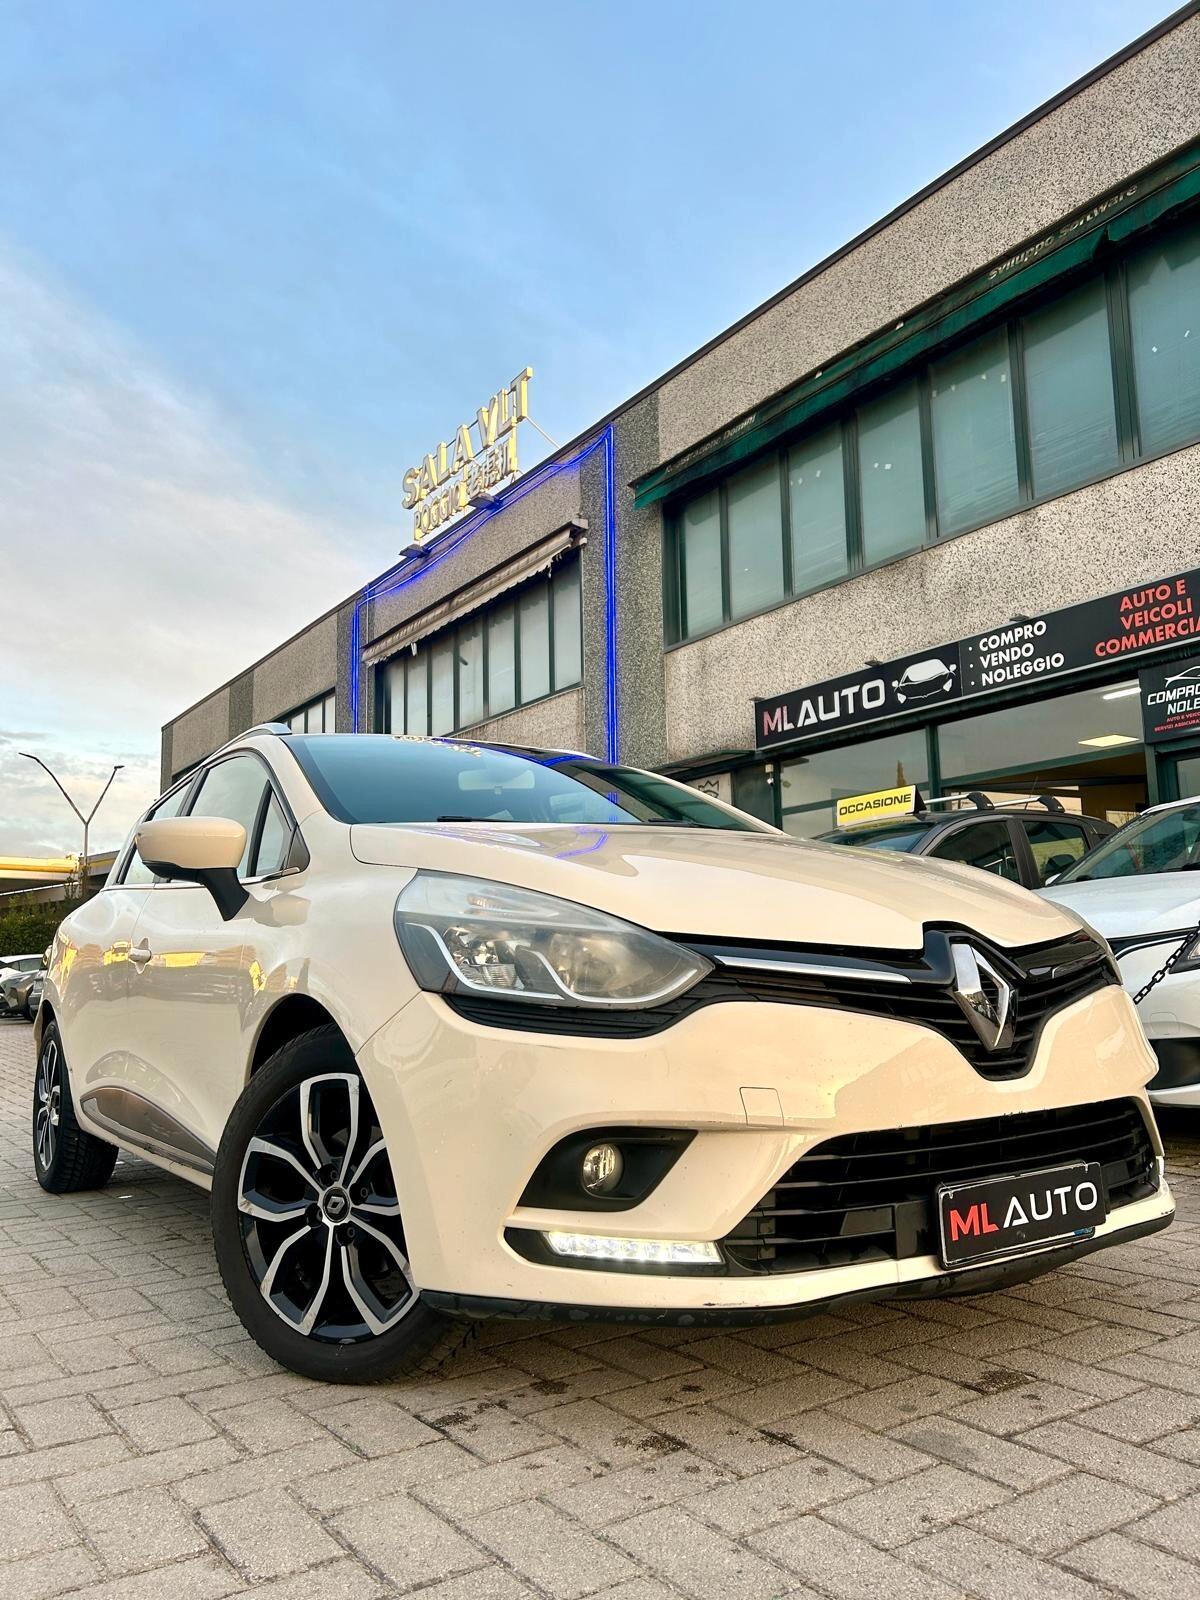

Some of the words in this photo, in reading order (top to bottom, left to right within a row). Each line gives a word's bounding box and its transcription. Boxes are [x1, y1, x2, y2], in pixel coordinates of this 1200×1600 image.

[402, 424, 475, 510] SALA
[1120, 584, 1171, 612] AUTO
[1176, 579, 1186, 596] E
[1120, 597, 1192, 631] VEICOLI
[979, 620, 1047, 652] COMPRO
[980, 643, 1034, 669] VENDO
[981, 652, 1065, 686] NOLEGGIO
[797, 678, 886, 727] AUTO
[839, 793, 912, 816] OCCASIONE
[950, 1202, 1000, 1241] ML
[1003, 1181, 1098, 1229] AUTO
